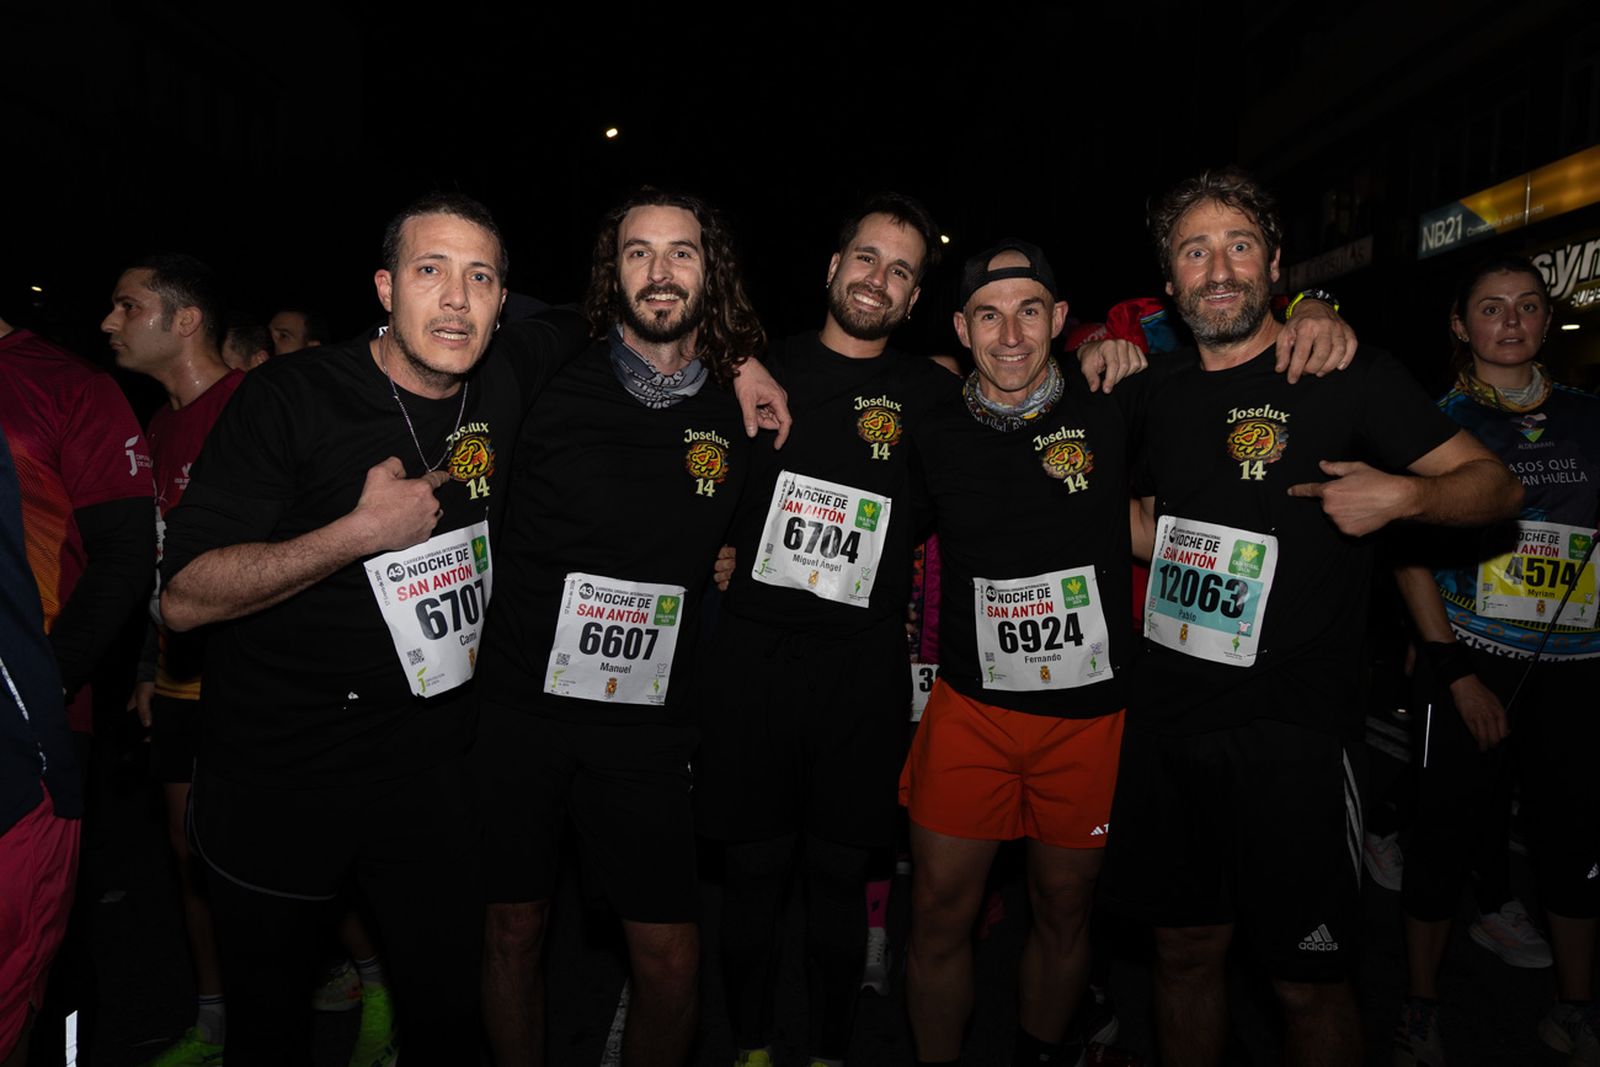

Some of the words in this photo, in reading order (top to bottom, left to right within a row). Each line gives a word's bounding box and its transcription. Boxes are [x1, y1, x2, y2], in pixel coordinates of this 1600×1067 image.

[1422, 214, 1463, 251] NB21
[854, 395, 902, 412] Joselux
[1226, 403, 1291, 424] Joselux
[683, 428, 730, 449] Joselux
[1032, 425, 1087, 451] Joselux
[870, 442, 891, 460] 14
[1240, 460, 1268, 481] 14
[1508, 460, 1544, 473] ASOS
[1548, 458, 1577, 471] QUE
[1063, 473, 1089, 494] 14
[1541, 471, 1589, 484] HUELLA
[466, 476, 491, 500] 14
[695, 478, 716, 498] 14
[795, 488, 831, 506] NOCHE
[833, 497, 848, 510] DE
[783, 516, 861, 564] 6704
[1204, 539, 1220, 553] DE
[1519, 532, 1547, 543] OCHE
[1548, 535, 1560, 545] DE
[1179, 549, 1217, 570] ANTÓN
[1521, 543, 1559, 557] ANTÓN
[407, 557, 454, 578] NOCHE
[456, 548, 469, 562] DE
[792, 554, 819, 567] Miguel
[387, 564, 404, 580] 43
[1504, 557, 1577, 590] 4574
[397, 581, 430, 602] SAN
[433, 564, 473, 589] ANTÓN
[1160, 563, 1249, 619] 12063
[1528, 588, 1555, 598] Myriam
[594, 592, 635, 607] NOCHE
[637, 598, 652, 609] DE
[998, 589, 1034, 604] NOCHE
[1037, 587, 1051, 599] DE
[415, 578, 487, 641] 6707
[577, 603, 605, 619] SAN
[606, 608, 649, 624] ANTÓN
[987, 605, 1009, 618] SAN
[1011, 600, 1053, 618] ANTÓN
[1178, 609, 1197, 622] Pablo
[579, 622, 659, 660] 6607
[998, 612, 1084, 654] 6924
[600, 662, 632, 674] Manuel
[1025, 654, 1062, 664] Fernando
[1297, 942, 1339, 952] adidas
